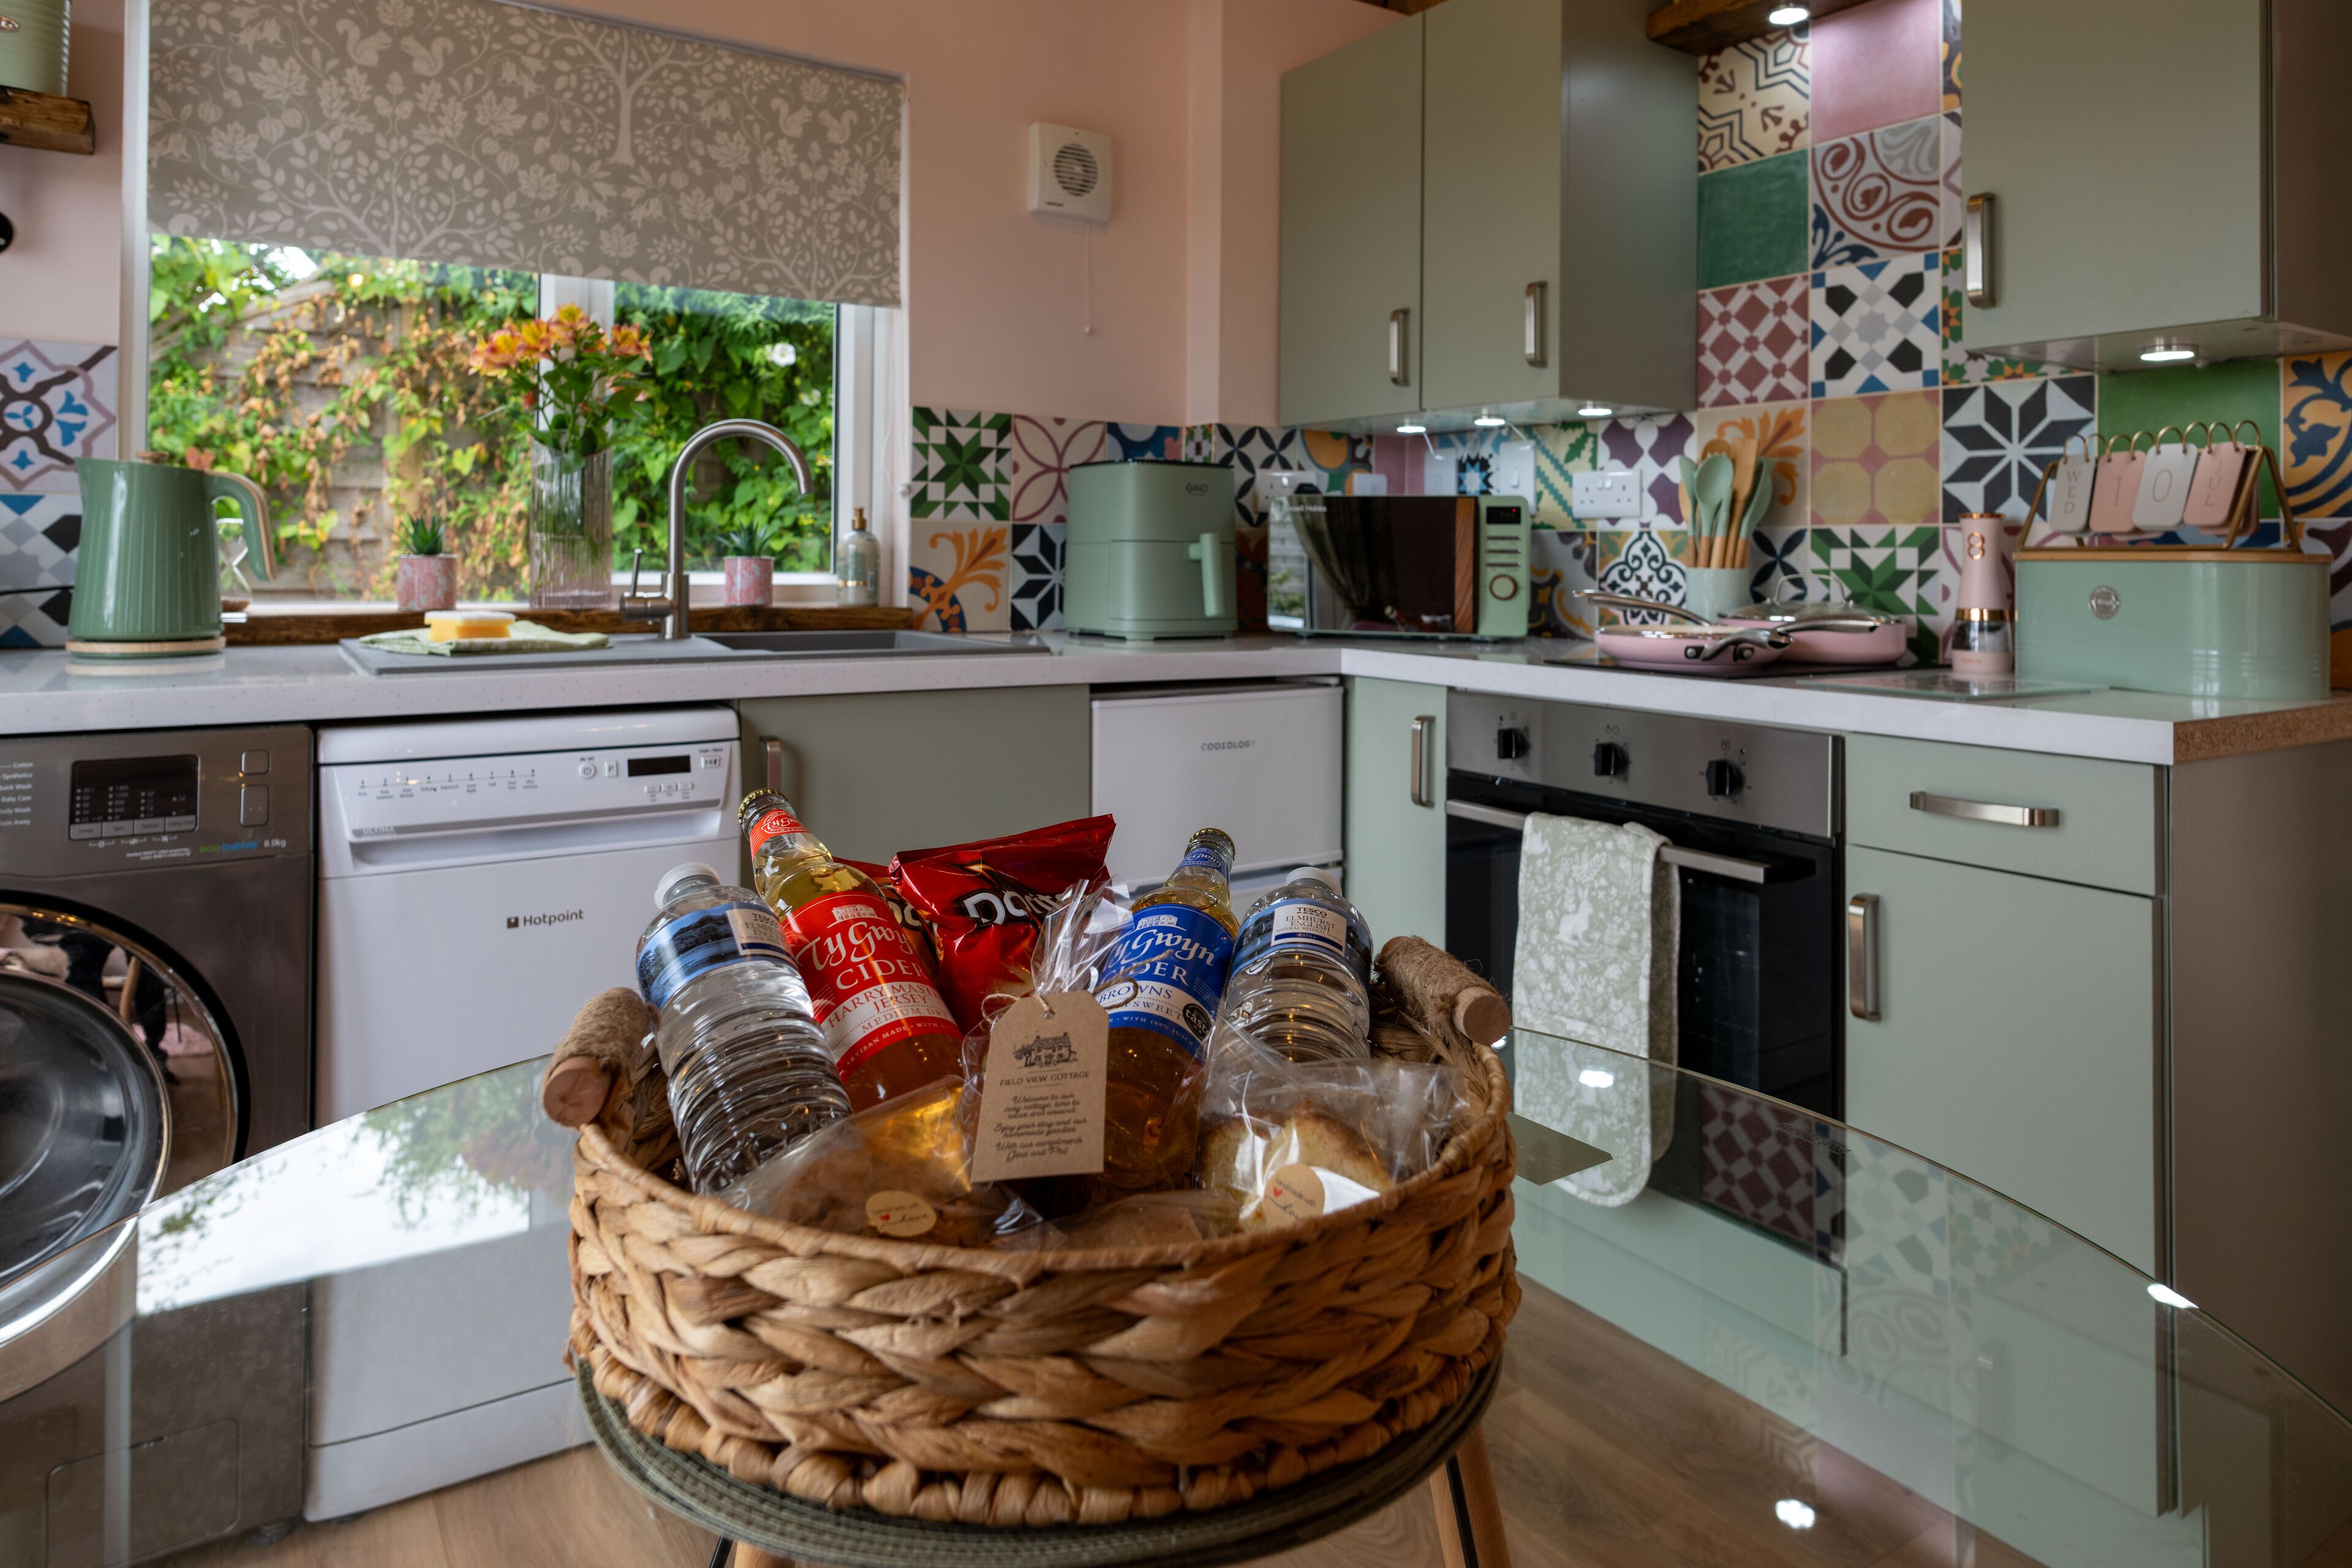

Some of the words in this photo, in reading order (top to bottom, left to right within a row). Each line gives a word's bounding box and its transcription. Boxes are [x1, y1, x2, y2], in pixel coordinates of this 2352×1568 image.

[781, 817, 799, 827] Gw
[263, 838, 287, 849] 8.0kg
[962, 890, 1078, 925] Dorit
[1296, 907, 1327, 916] TESCO
[523, 908, 584, 927] Hotpoint
[1286, 915, 1336, 929] ELMHURST
[1291, 921, 1330, 932] ENGLISH
[796, 932, 846, 971] Ty
[848, 921, 913, 962] Gwy
[1120, 929, 1215, 966] Gwyn
[836, 959, 929, 990] CIDER
[873, 993, 927, 1014] JERSEY
[1099, 984, 1173, 1004] BROWNS
[828, 986, 884, 1028] HARRY
[891, 983, 941, 1001] MASTE
[1133, 1000, 1185, 1020] SWEET
[861, 1008, 922, 1033] MEDIUM
[927, 1008, 950, 1019] DRY
[1150, 1020, 1169, 1030] 100%
[1172, 1028, 1194, 1046] JUICE
[846, 1037, 880, 1067] ARTISAN
[882, 1025, 908, 1039] MADE
[1000, 1077, 1023, 1087] FIELD
[1026, 1075, 1048, 1084] VIEW
[1050, 1071, 1090, 1081] COTTAGE
[1012, 1095, 1049, 1103] Welcome
[993, 1122, 1016, 1133] Enjoy
[1017, 1121, 1035, 1131] your
[1046, 1126, 1076, 1136] goodies
[995, 1141, 1017, 1150] With
